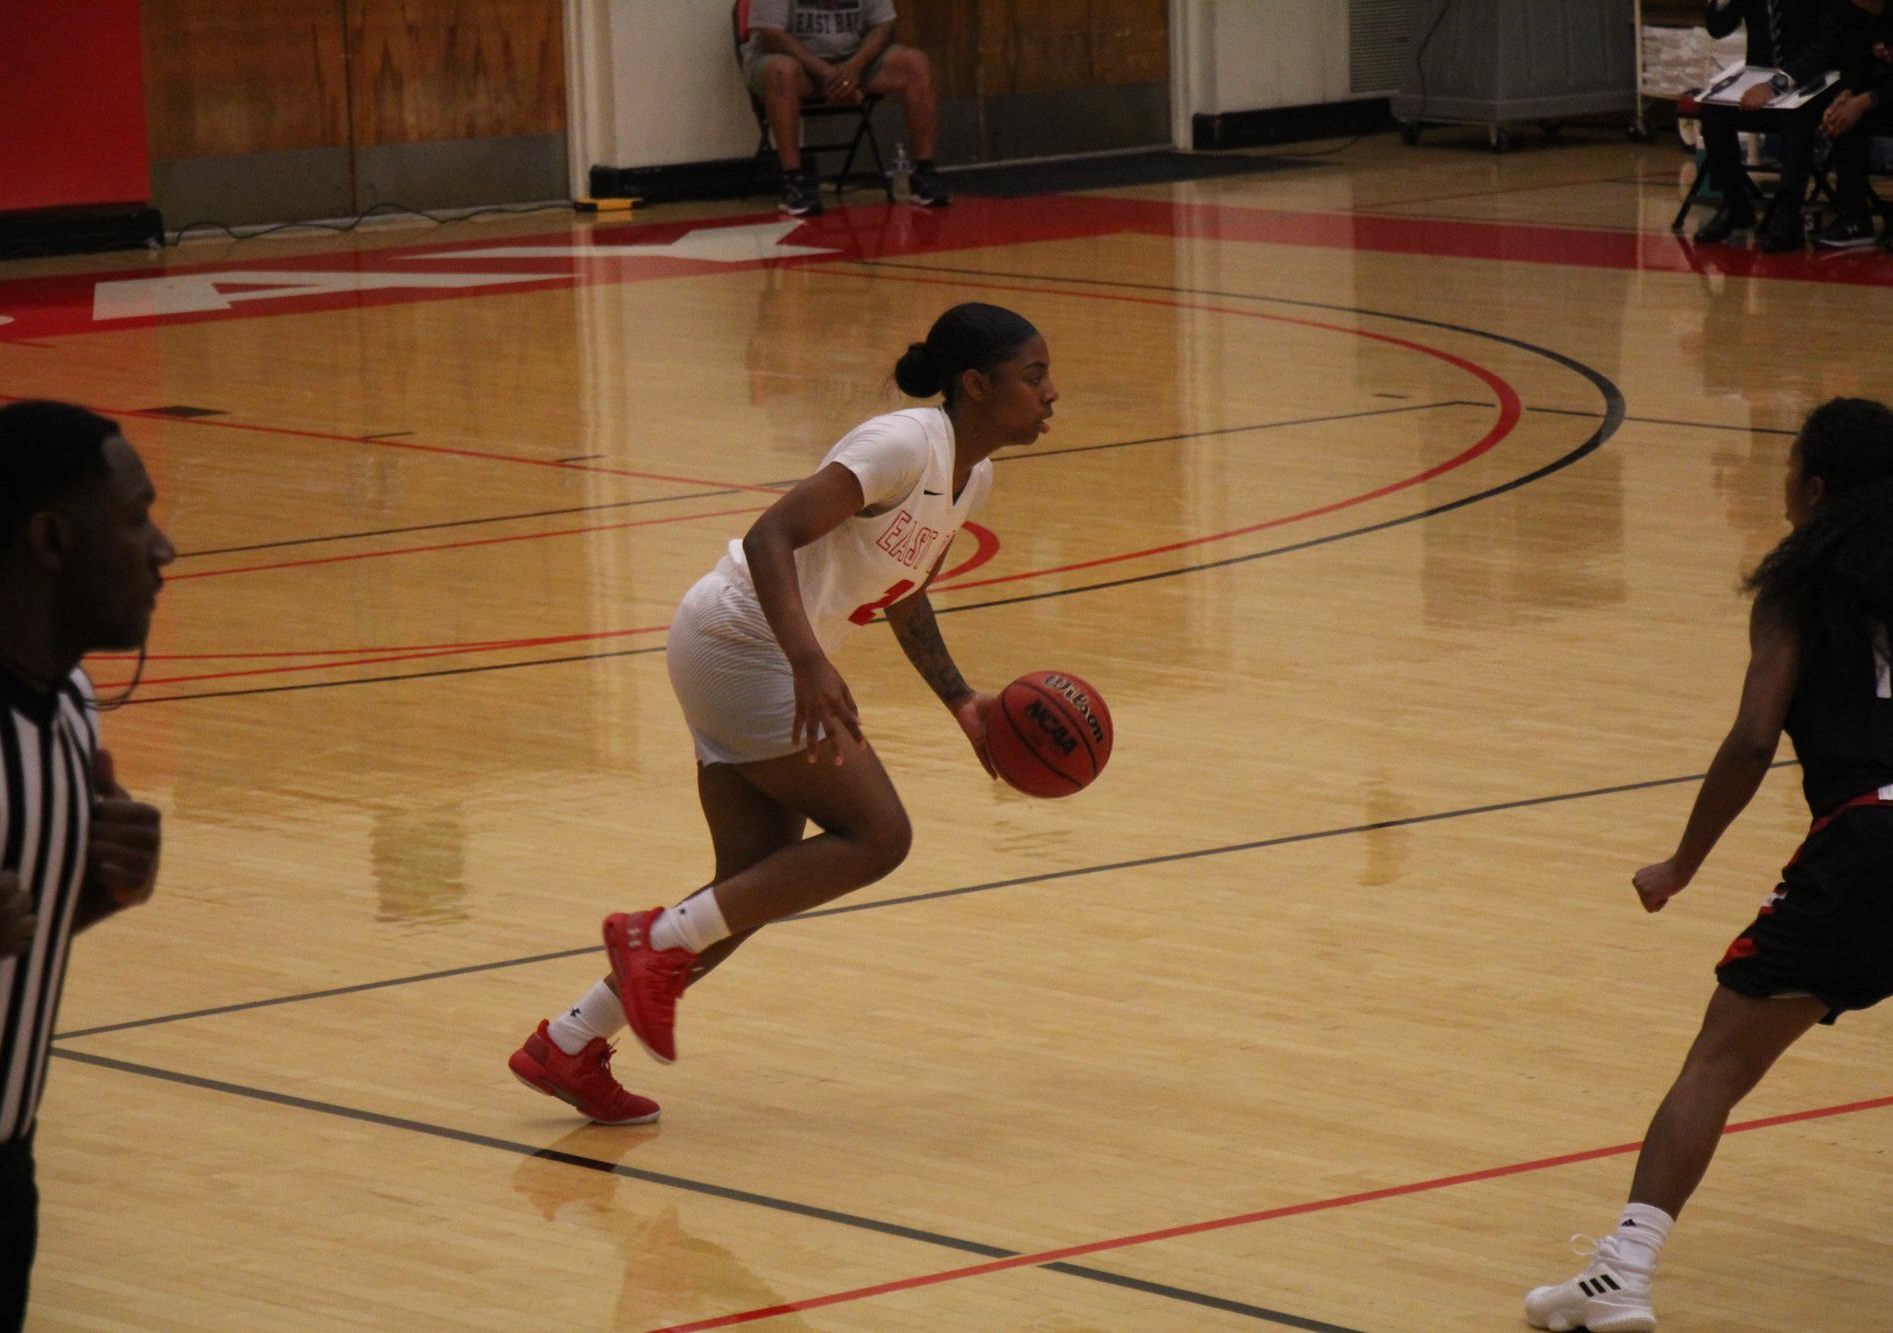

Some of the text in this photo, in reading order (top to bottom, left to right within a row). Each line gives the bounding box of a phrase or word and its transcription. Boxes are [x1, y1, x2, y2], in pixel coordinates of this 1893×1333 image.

[796, 12, 830, 34] EAST
[0, 221, 842, 327] AY
[876, 510, 939, 570] EAST
[1025, 700, 1078, 756] NCAA
[1043, 675, 1104, 743] Wilson
